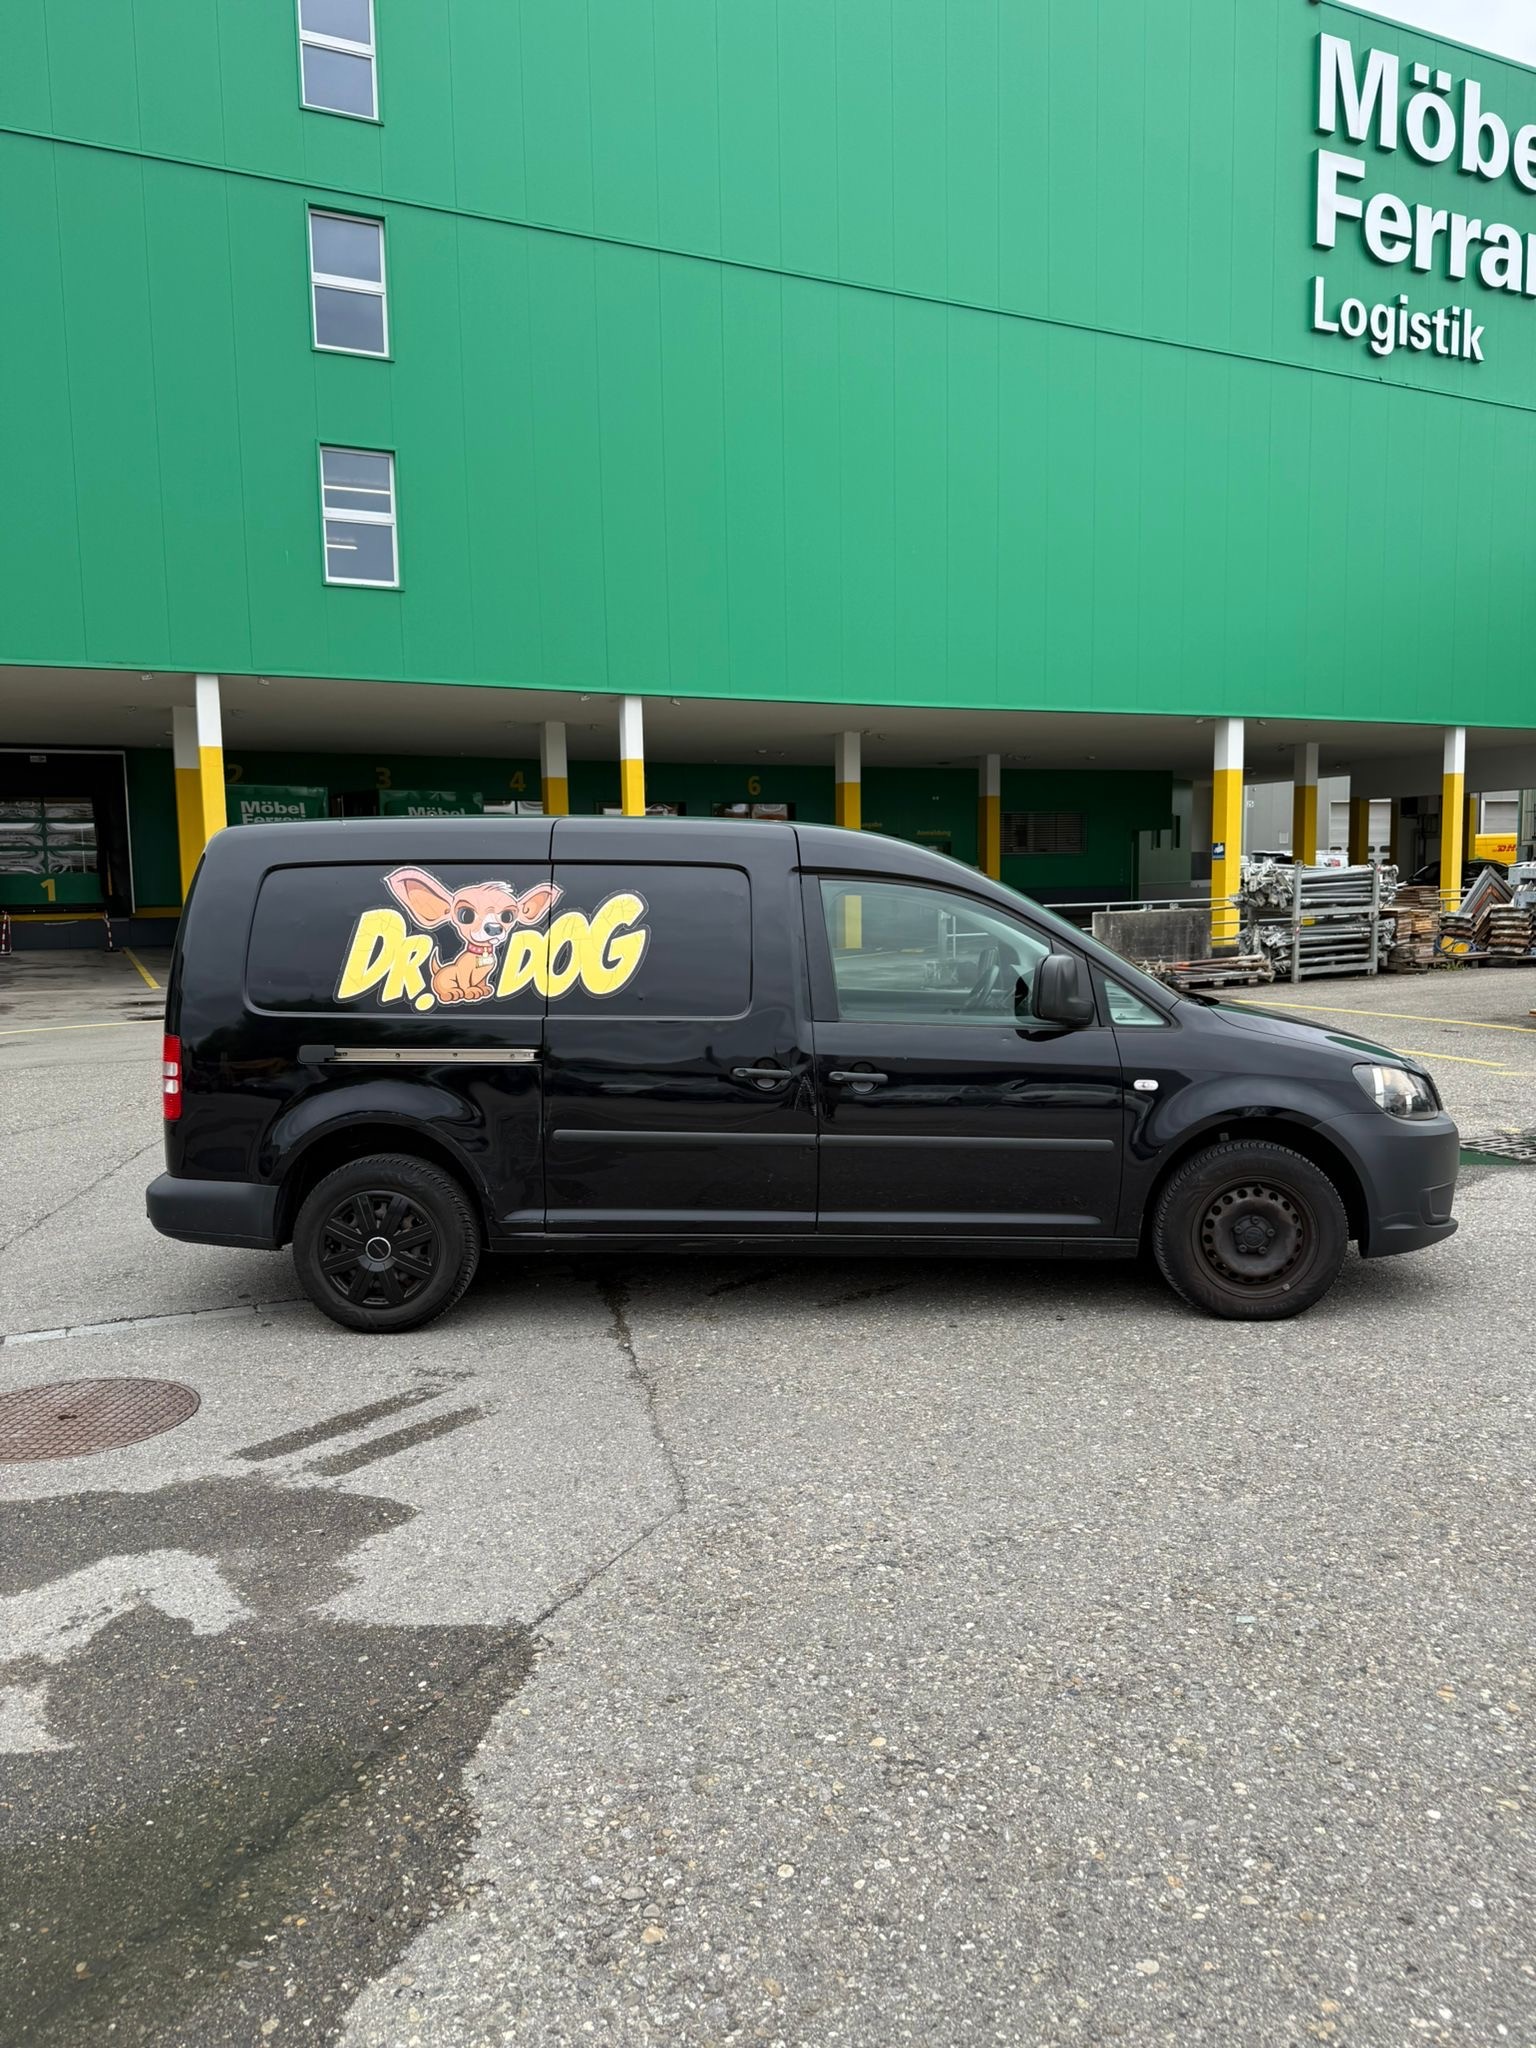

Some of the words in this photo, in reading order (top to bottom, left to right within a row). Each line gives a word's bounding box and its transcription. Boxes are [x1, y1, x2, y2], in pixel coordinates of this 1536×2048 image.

[1313, 276, 1485, 362] Logistik
[375, 767, 391, 789] 3
[509, 770, 526, 792] 4
[748, 776, 761, 796] 6
[240, 801, 306, 816] Möbel
[40, 878, 56, 902] 1
[338, 908, 435, 1011] DR.
[496, 893, 646, 998] DOG
